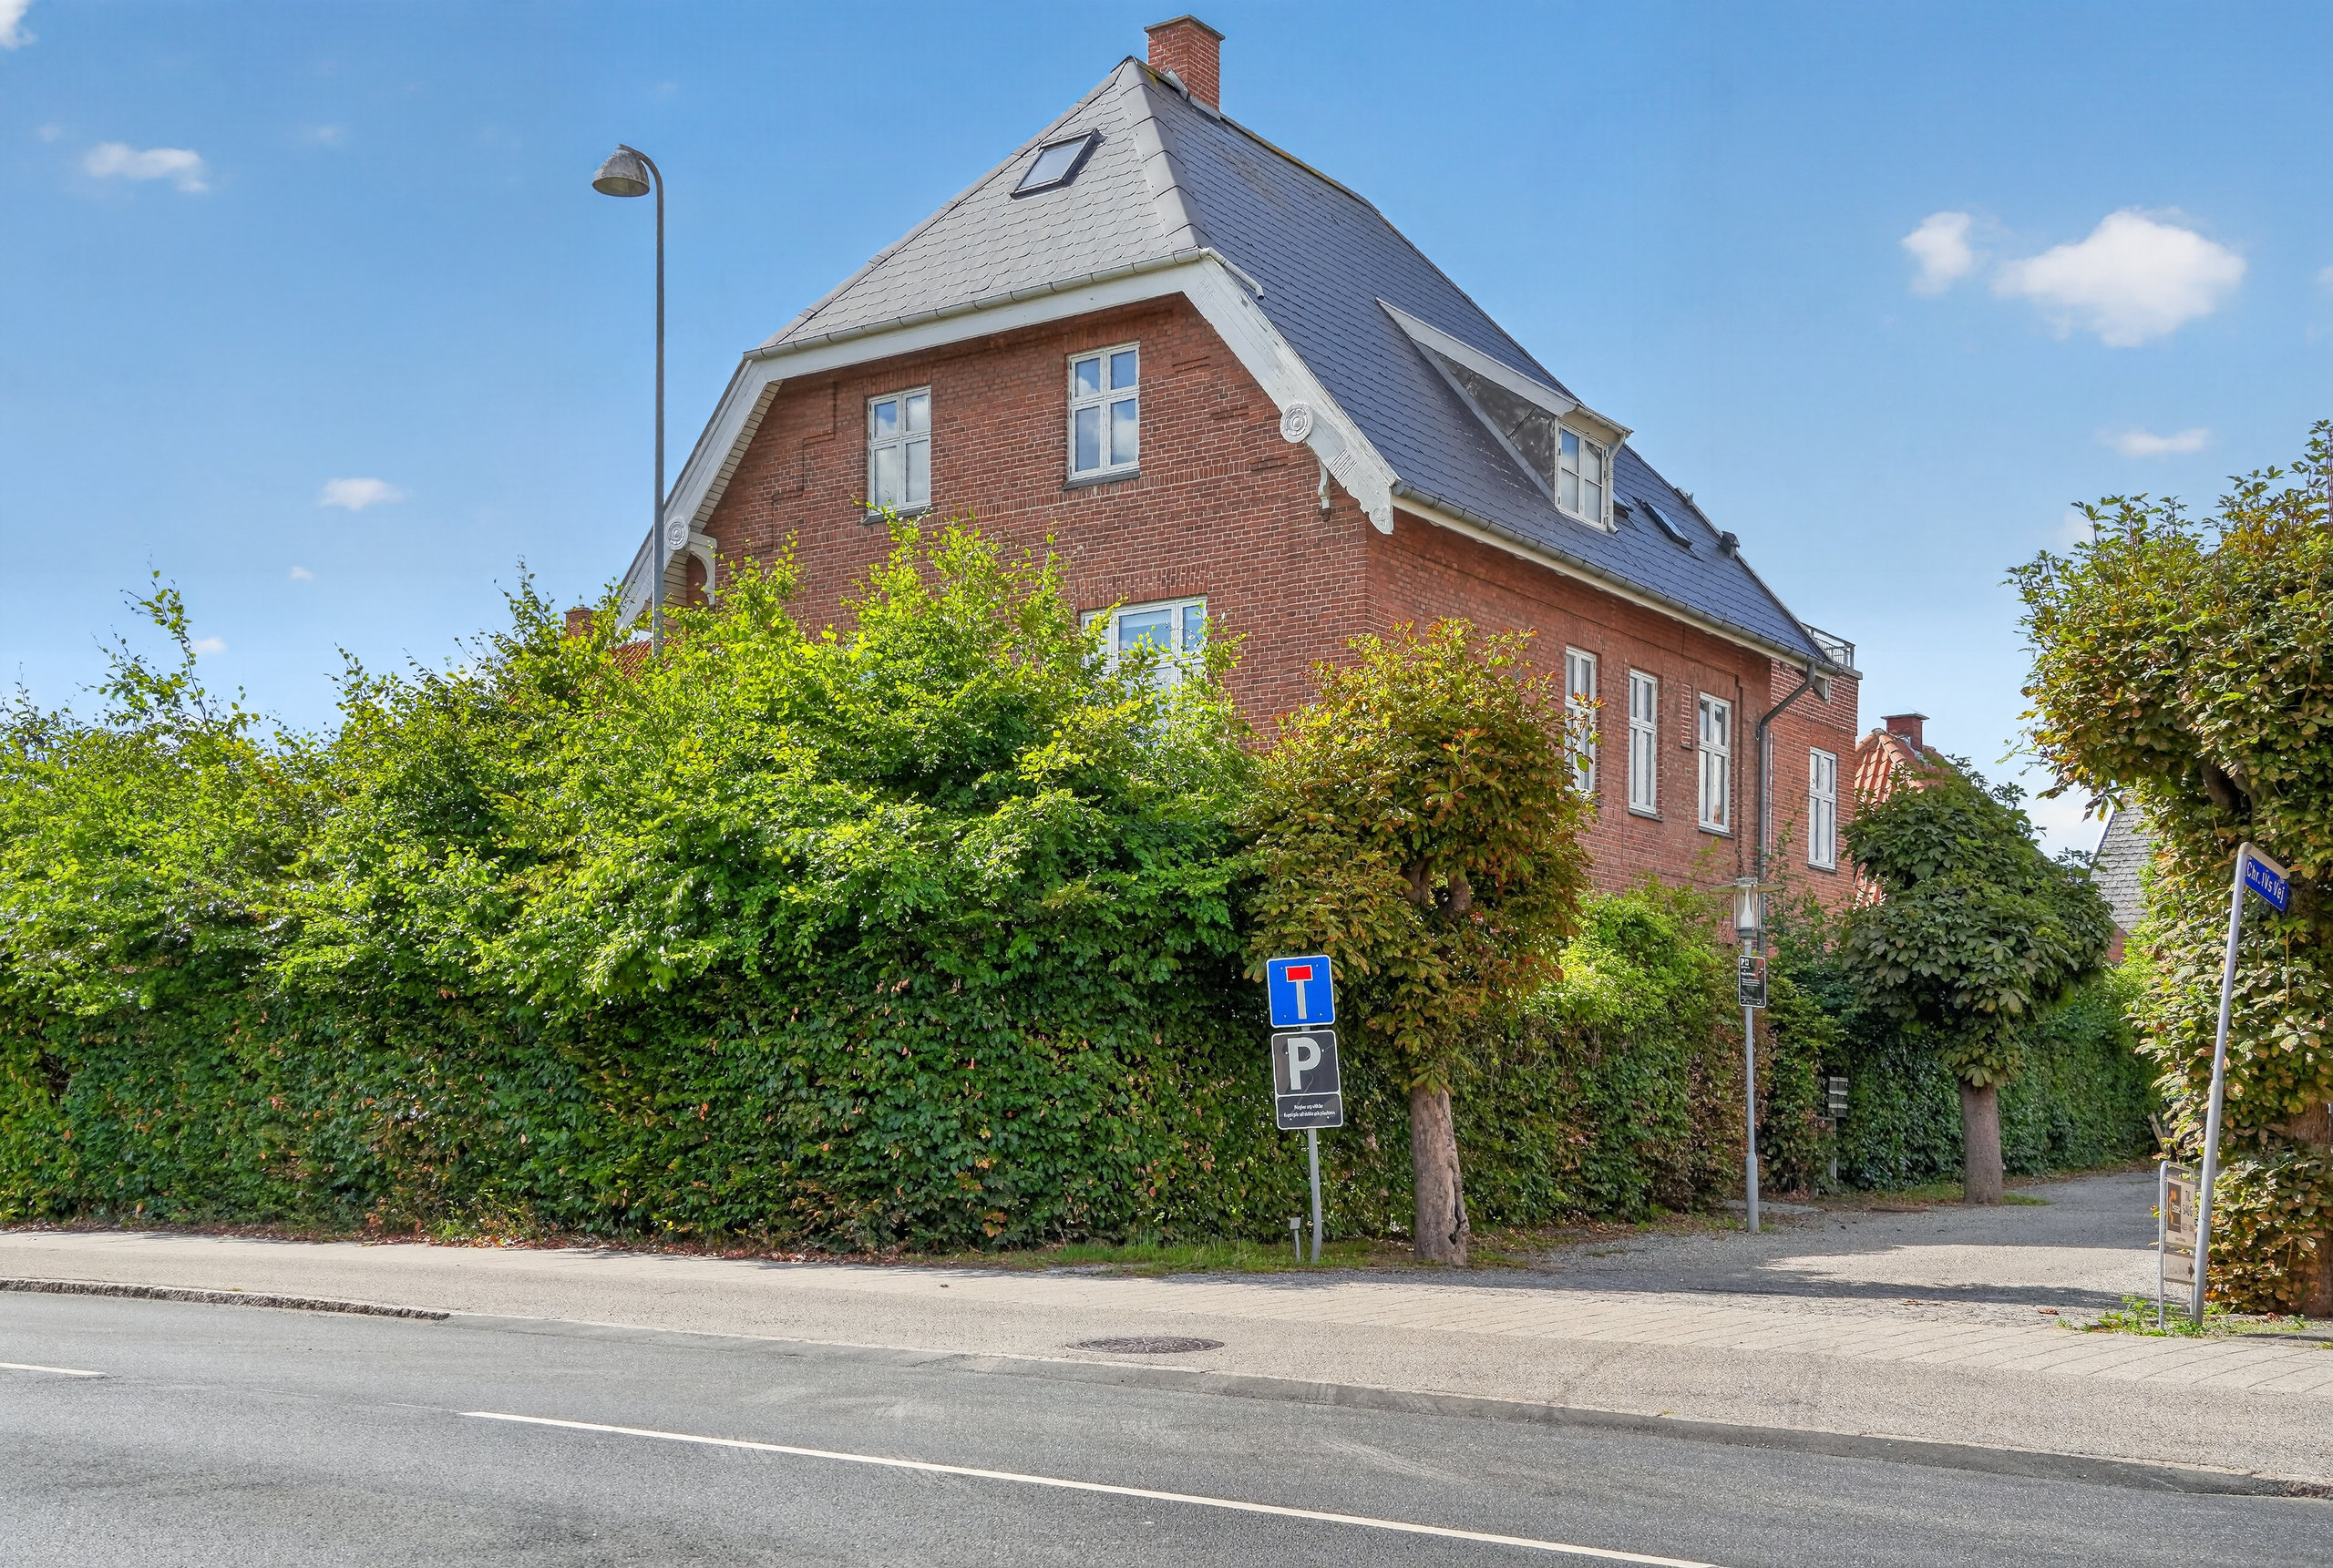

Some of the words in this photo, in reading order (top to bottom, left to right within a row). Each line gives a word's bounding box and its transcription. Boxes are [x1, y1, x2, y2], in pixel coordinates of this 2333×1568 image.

[2246, 862, 2260, 884] Chr.
[2273, 880, 2286, 904] Vej
[1287, 1037, 1321, 1091] P
[2183, 1204, 2194, 1217] SALG
